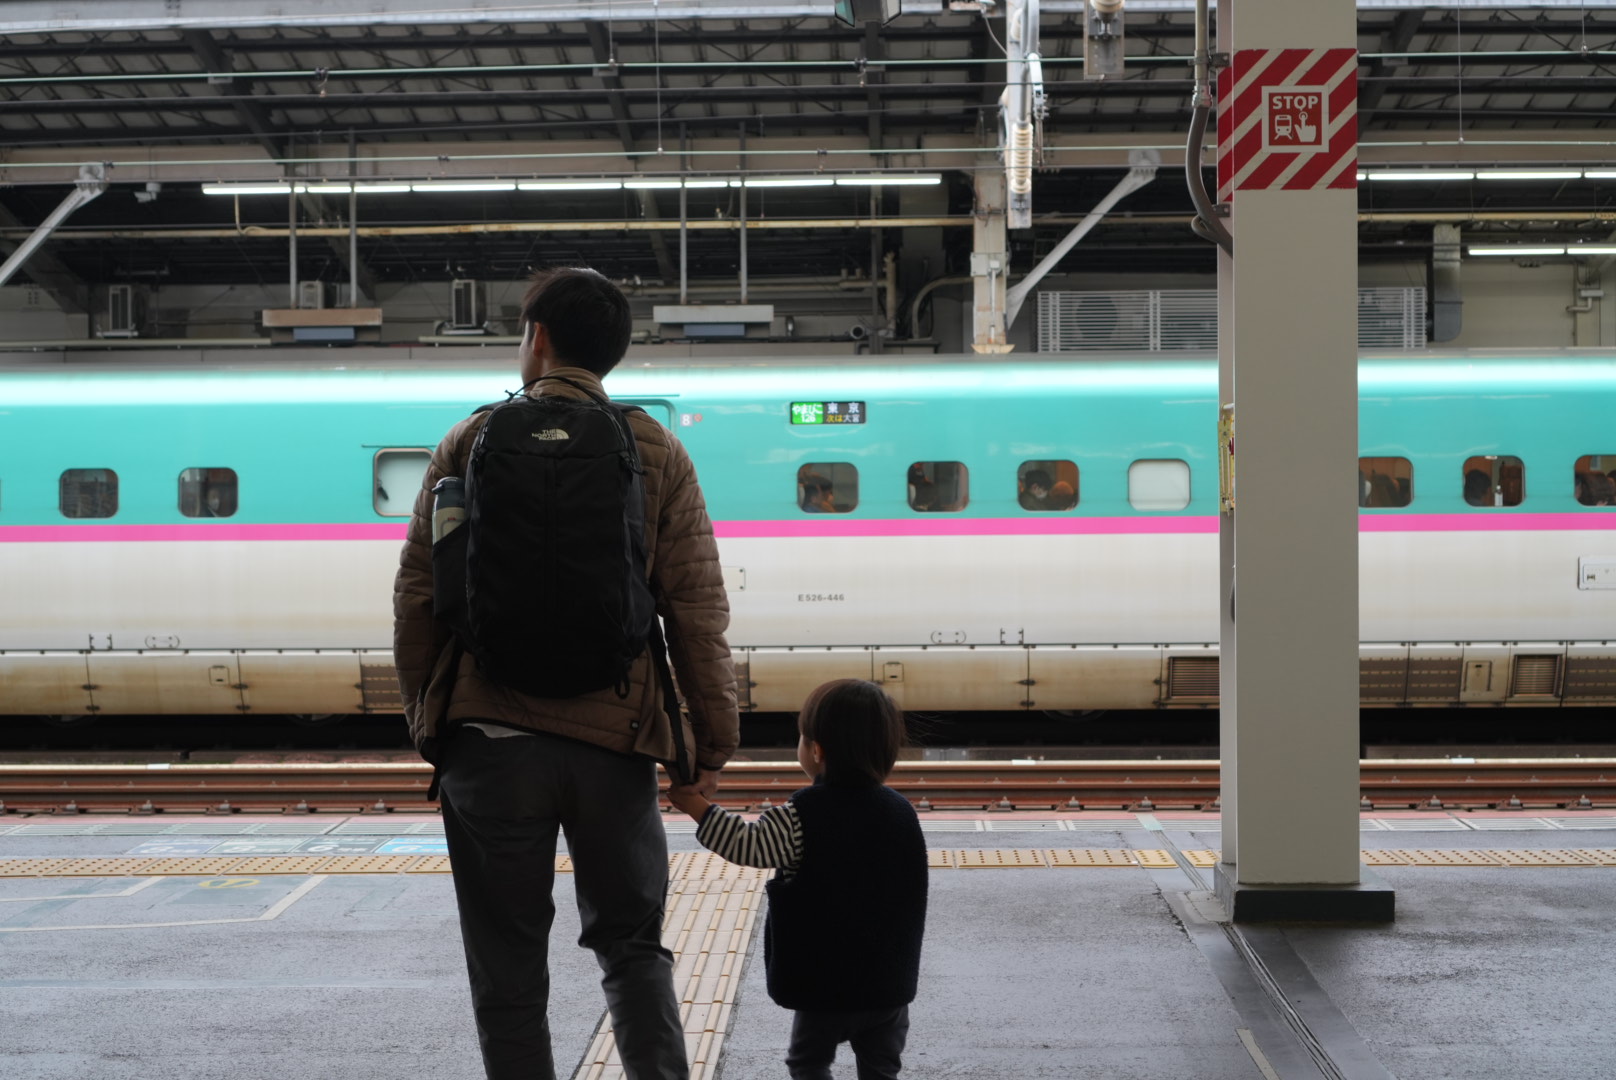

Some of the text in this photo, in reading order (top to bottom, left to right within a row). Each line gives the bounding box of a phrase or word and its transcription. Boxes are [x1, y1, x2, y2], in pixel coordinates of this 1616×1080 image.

[1272, 95, 1319, 111] STOP
[792, 403, 824, 415] やまびこ
[827, 402, 860, 414] 東京
